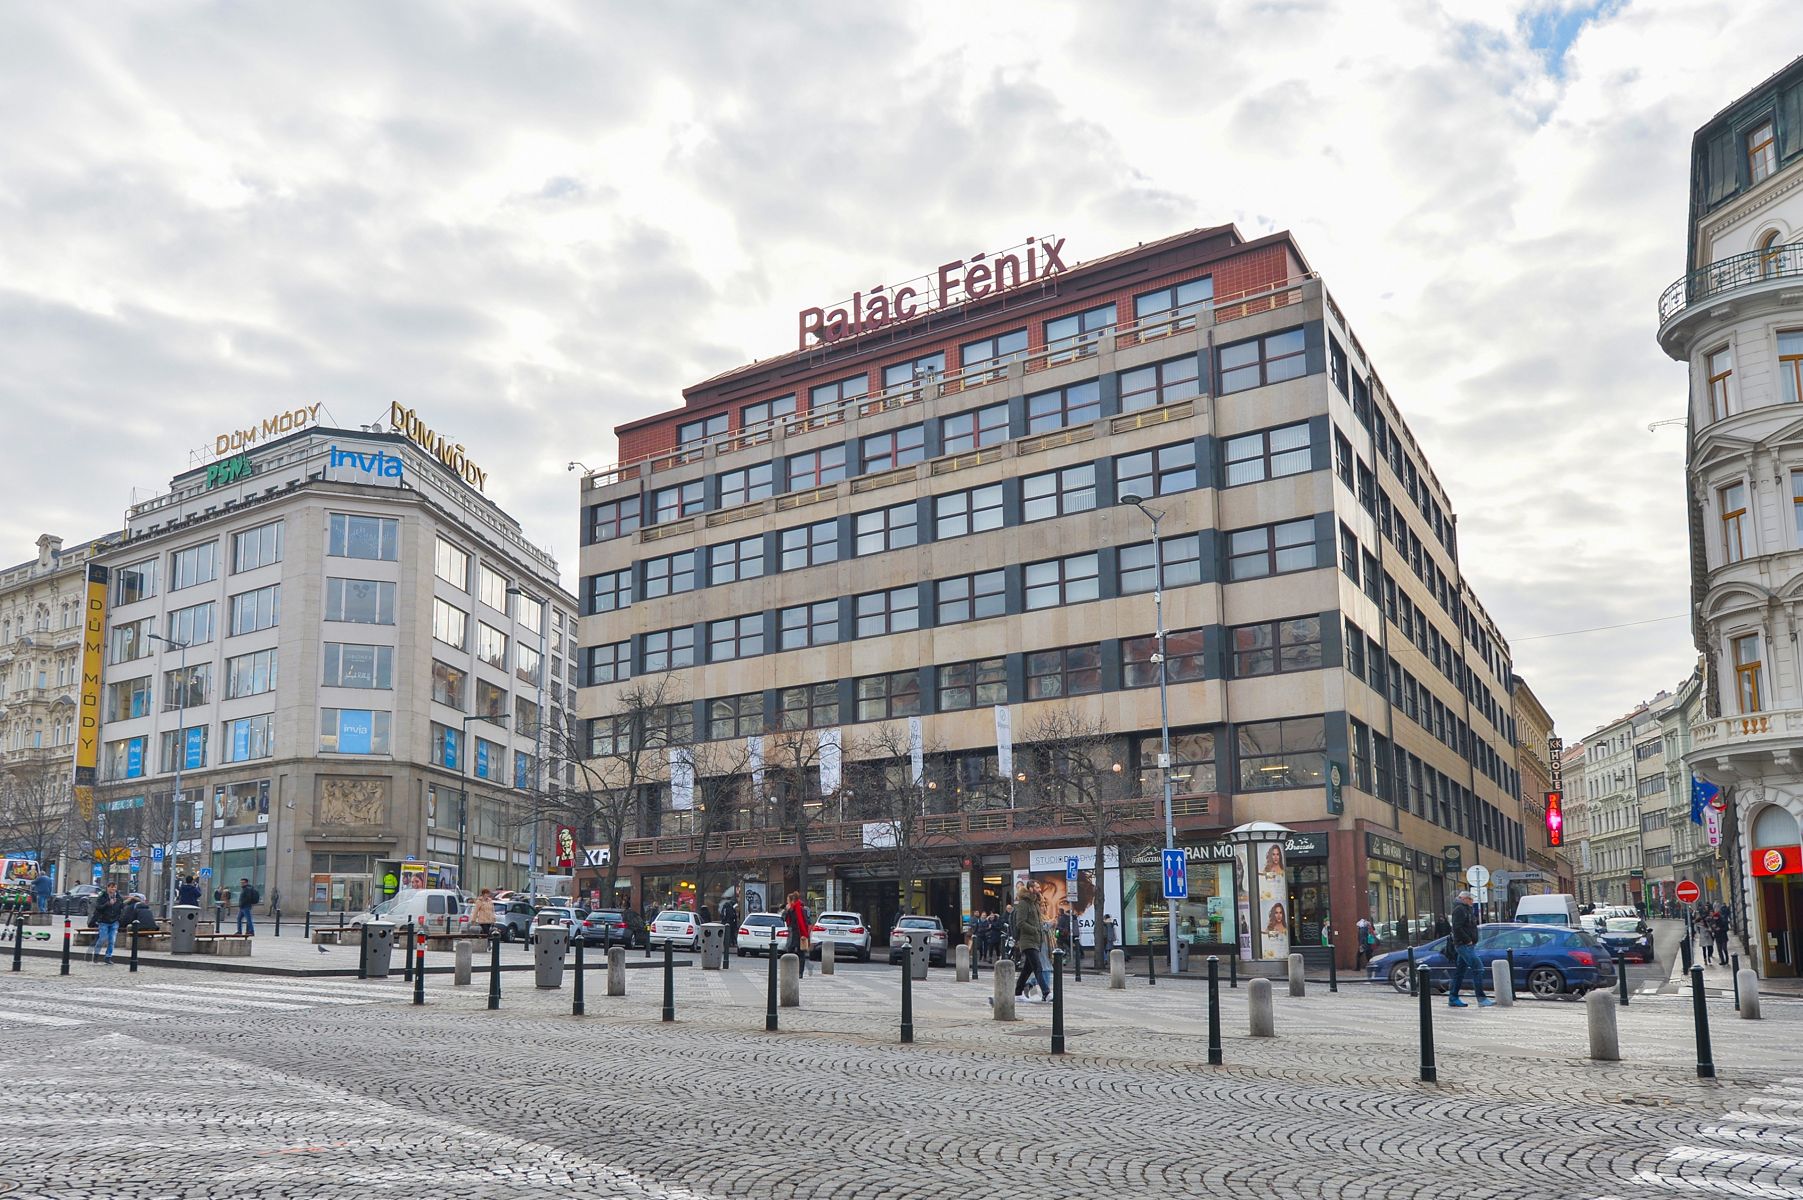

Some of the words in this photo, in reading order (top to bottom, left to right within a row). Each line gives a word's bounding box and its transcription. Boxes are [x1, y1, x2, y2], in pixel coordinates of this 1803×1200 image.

[799, 285, 917, 351] Palác
[938, 236, 1067, 308] Fénix
[216, 426, 256, 456] DŮM
[262, 402, 320, 439] MÓDY
[391, 400, 435, 454] DŮM
[330, 445, 403, 478] invia
[86, 599, 103, 654] DŮM
[81, 672, 98, 750] MÓDY
[1551, 752, 1561, 790] HOTE
[1179, 845, 1209, 860] RAN
[1213, 844, 1236, 859] MO
[1708, 817, 1718, 844] LUB
[1079, 918, 1119, 928] SAXA
